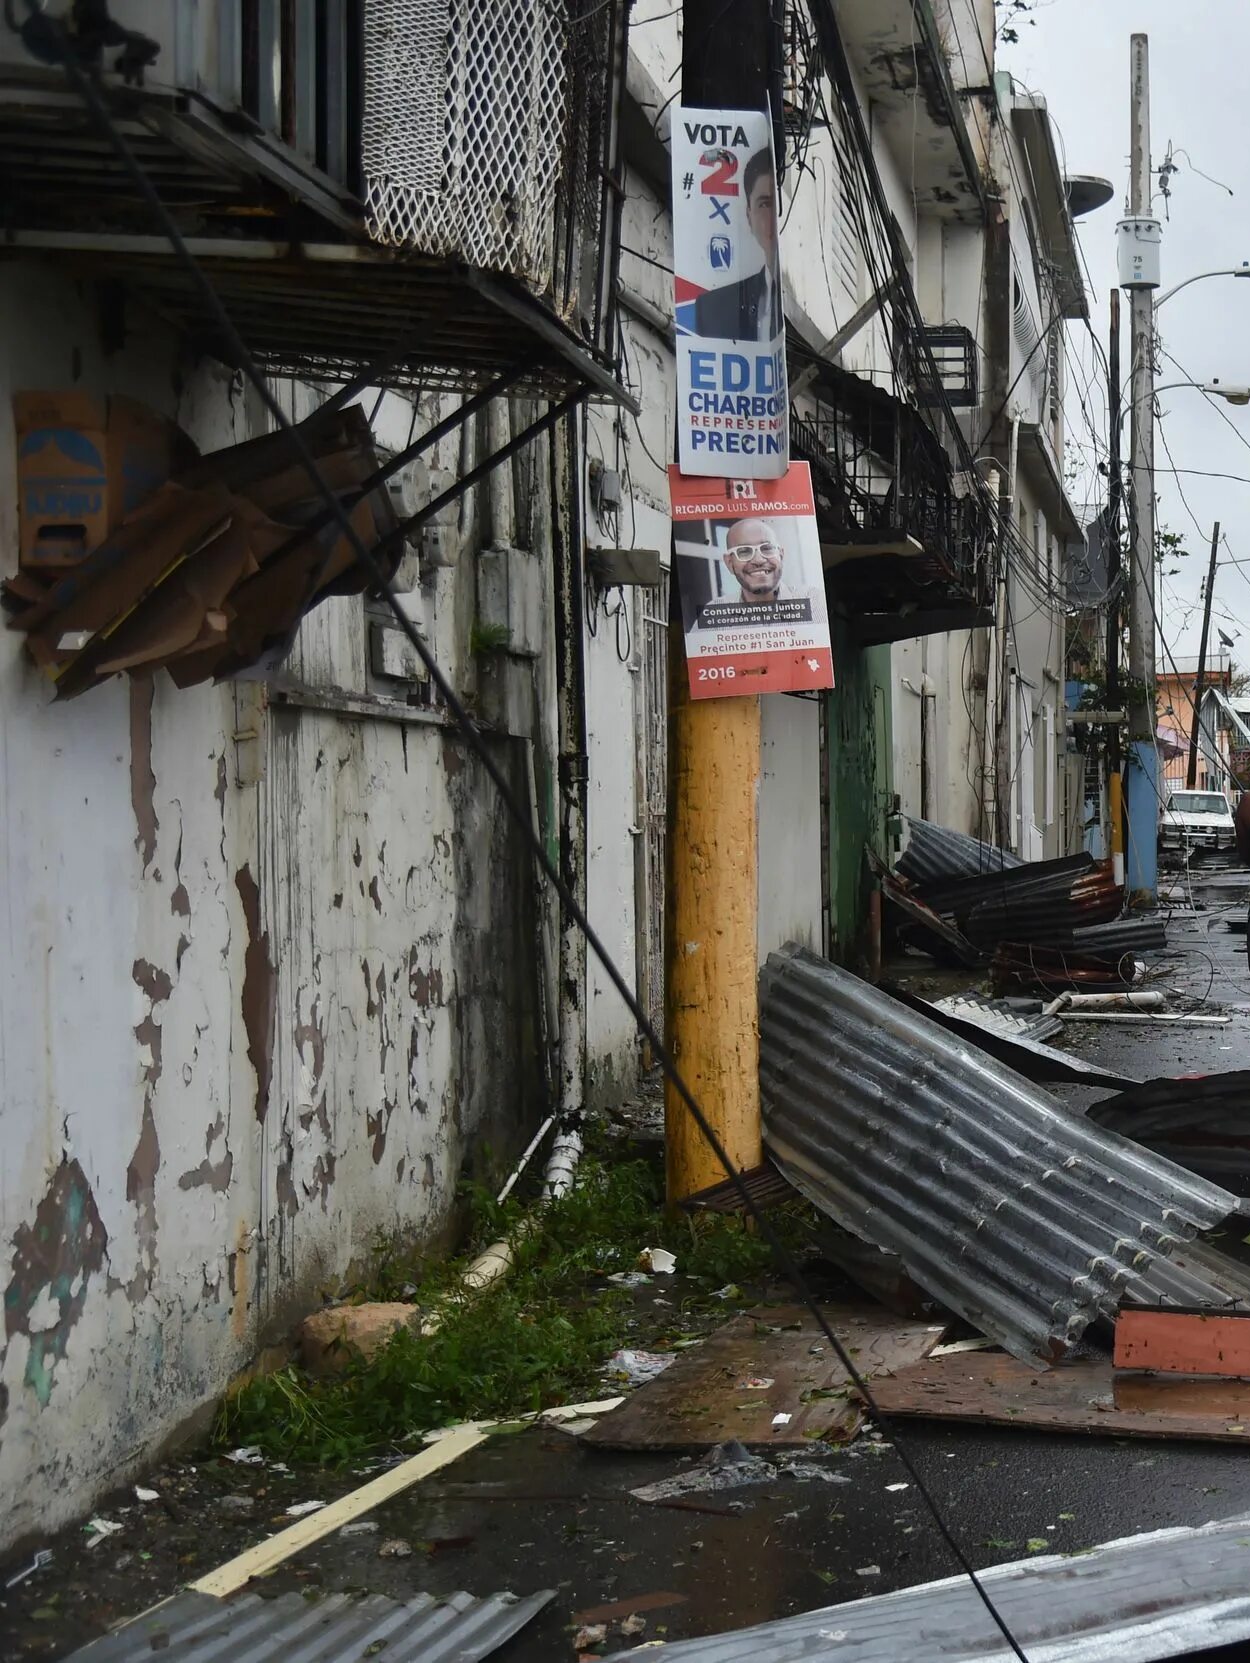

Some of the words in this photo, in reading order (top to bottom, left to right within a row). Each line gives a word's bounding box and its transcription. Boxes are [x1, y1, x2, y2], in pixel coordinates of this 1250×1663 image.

[684, 122, 750, 148] VOTA
[1133, 255, 1143, 263] 75
[675, 504, 724, 515] RICARDO
[727, 503, 748, 513] LUIS
[751, 501, 809, 512] RAMOS.com
[702, 605, 773, 617] Construyamos
[717, 616, 749, 625] corazón
[752, 614, 761, 622] de
[717, 629, 796, 643] Representante
[700, 643, 747, 655] Precinto
[750, 641, 762, 649] #1
[766, 640, 786, 649] San
[789, 639, 815, 647] Juan
[698, 666, 736, 681] 2016
